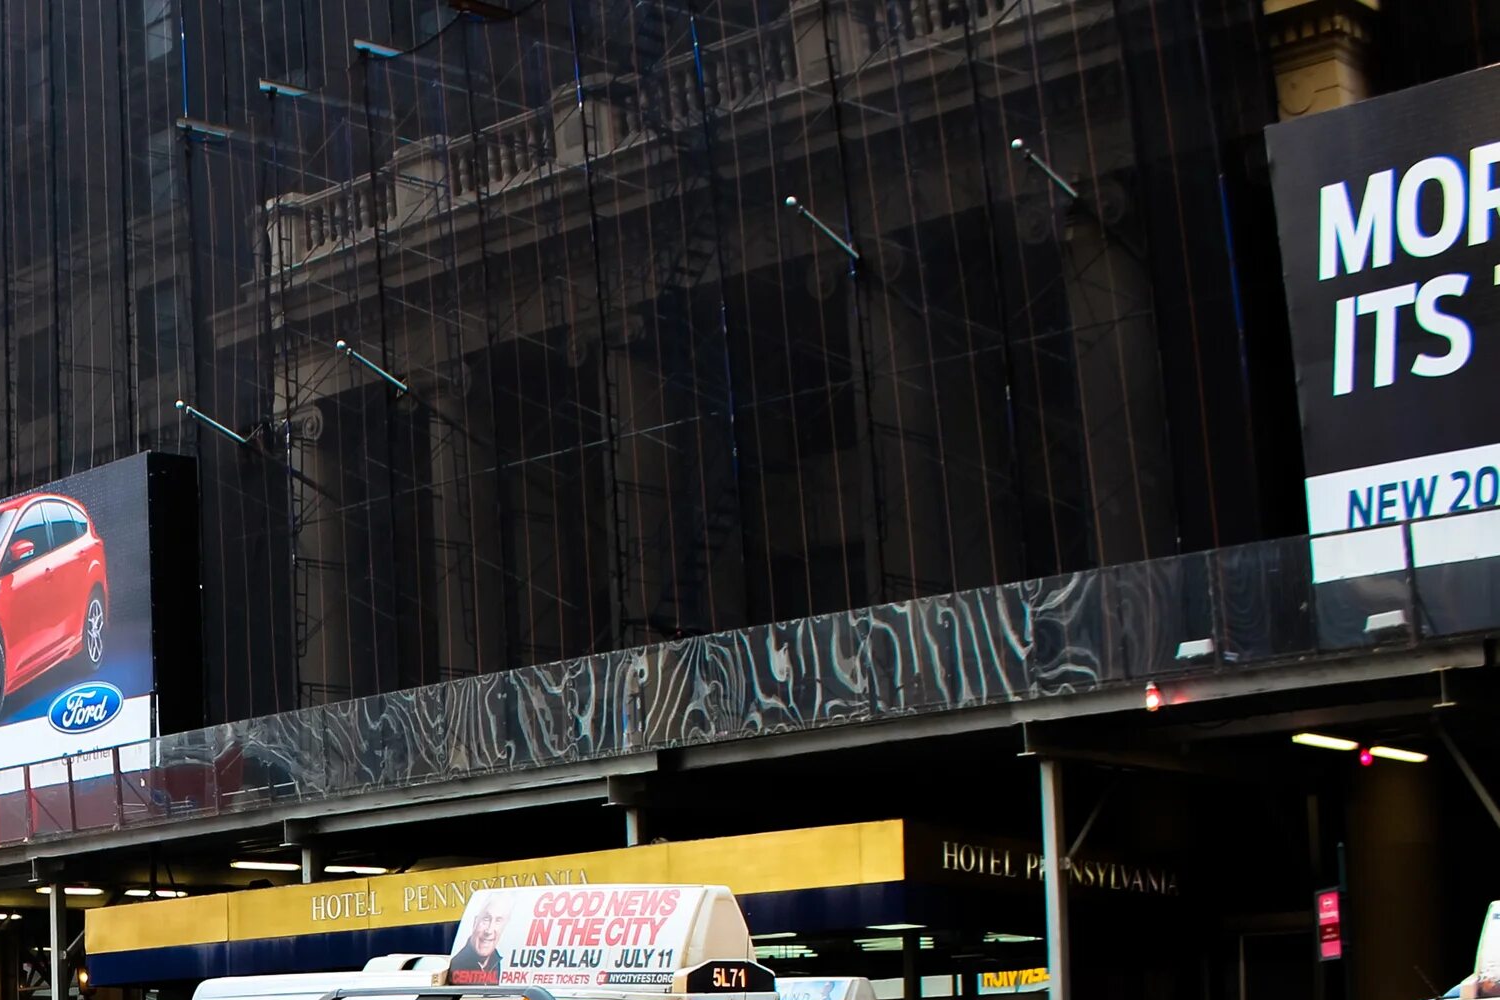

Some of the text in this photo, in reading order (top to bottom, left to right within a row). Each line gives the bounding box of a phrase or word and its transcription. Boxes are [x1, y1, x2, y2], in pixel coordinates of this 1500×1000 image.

[1333, 273, 1474, 397] ITS
[1346, 474, 1439, 529] NEW
[62, 690, 108, 728] Ford
[942, 840, 1015, 877] HOTEL
[311, 890, 382, 921] HOTEL
[533, 889, 681, 917] GOOD NEWS
[526, 917, 669, 947] IN THE CITY
[509, 949, 674, 968] LUIS PALAU JULY 11
[451, 970, 674, 985] CENTRAL PARK FREE TICKETS NYCITYFEST.ORG
[713, 968, 747, 988] 5L71
